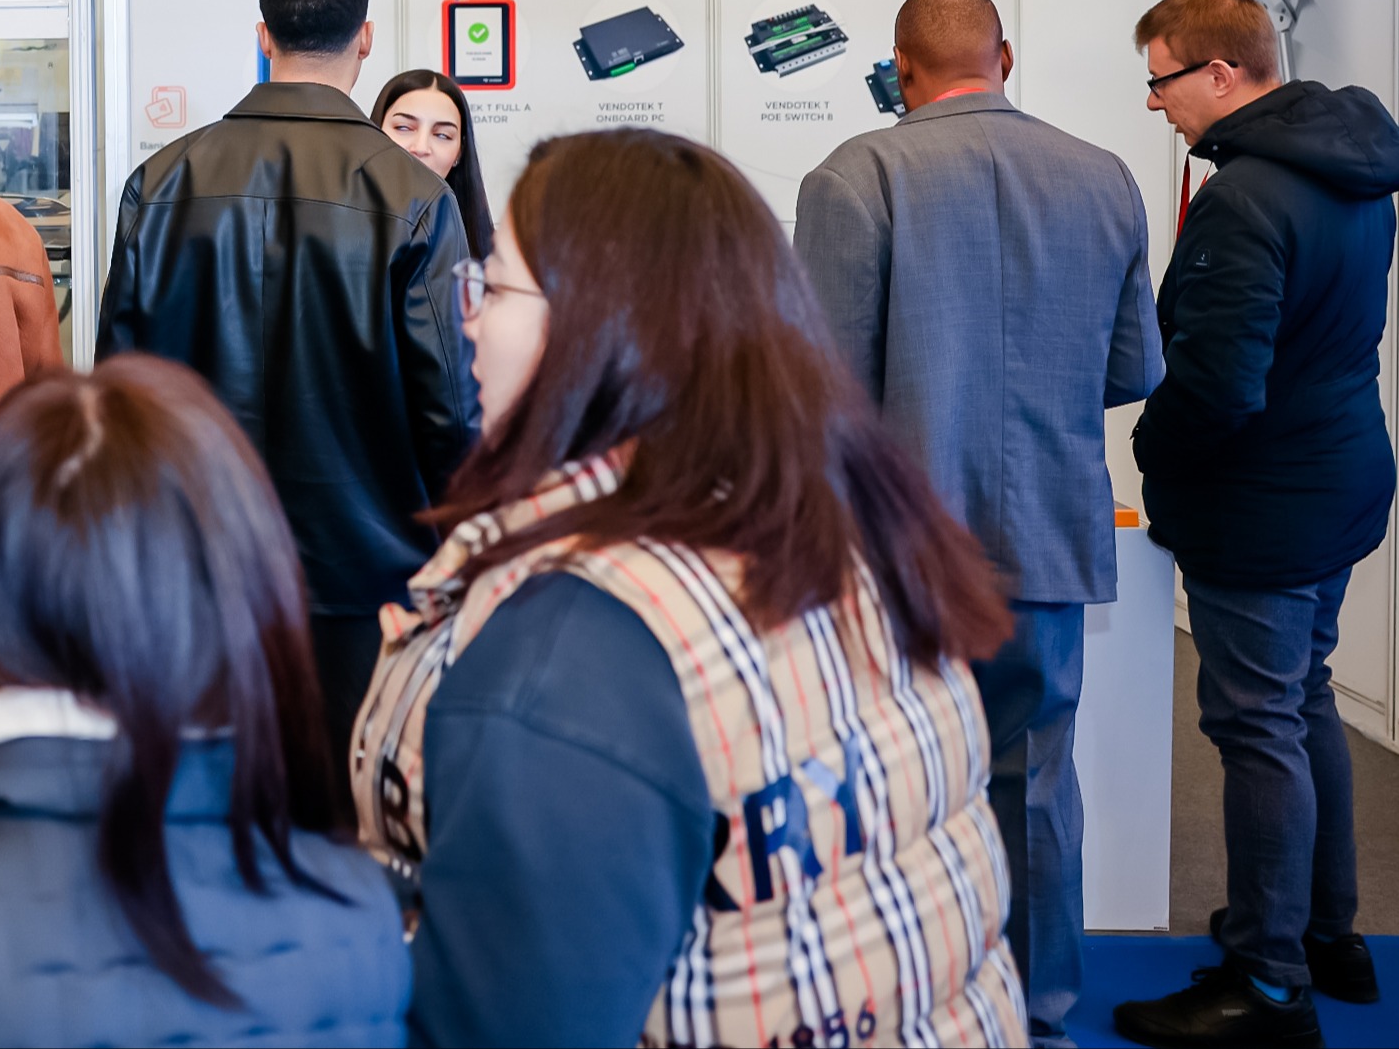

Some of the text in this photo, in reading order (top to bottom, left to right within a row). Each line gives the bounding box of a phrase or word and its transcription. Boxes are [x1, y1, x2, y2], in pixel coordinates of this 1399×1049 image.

[598, 102, 654, 112] VENDOTEK
[765, 101, 821, 110] VENDOTEK
[473, 115, 509, 124] DATOR
[596, 114, 649, 123] ONBOARD
[761, 113, 781, 121] POE
[785, 112, 825, 121] SWITCH
